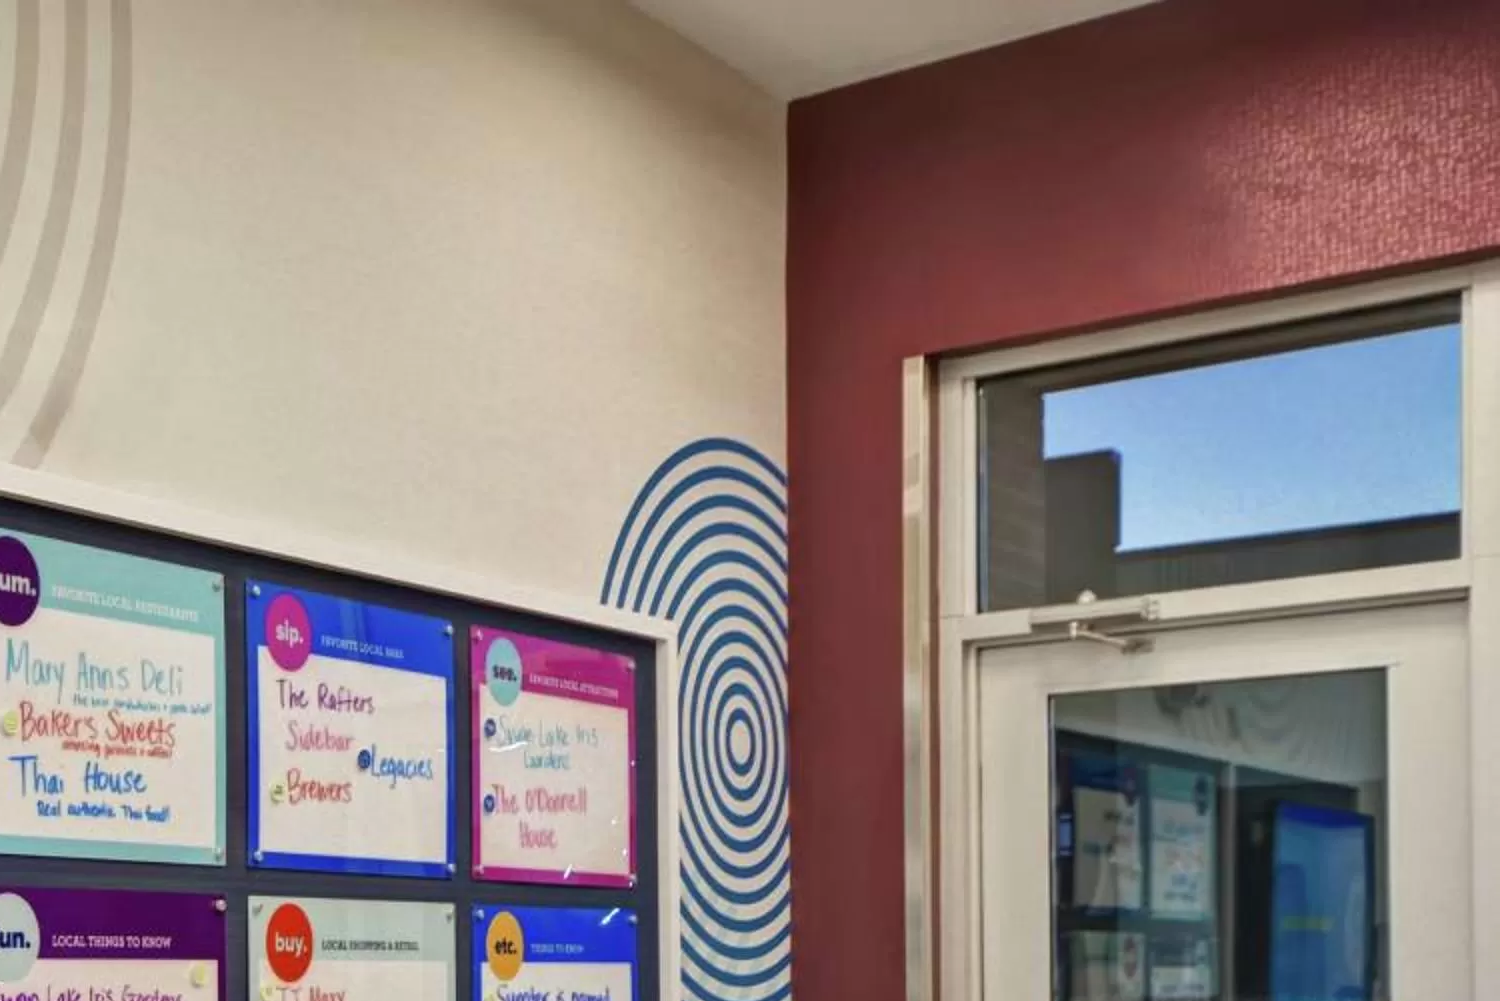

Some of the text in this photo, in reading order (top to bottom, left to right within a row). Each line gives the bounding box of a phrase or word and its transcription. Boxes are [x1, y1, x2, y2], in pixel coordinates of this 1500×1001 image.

[5, 638, 66, 704] Mary
[140, 659, 185, 697] Deli
[276, 678, 309, 710] The
[105, 708, 177, 747] Sweets
[8, 754, 148, 797] Thai House
[371, 743, 434, 790] Legacies
[287, 767, 353, 806] Brewers
[52, 934, 172, 949] LOCAL THINGS TO KNOW
[275, 931, 308, 958] buy.
[495, 936, 518, 956] etc.
